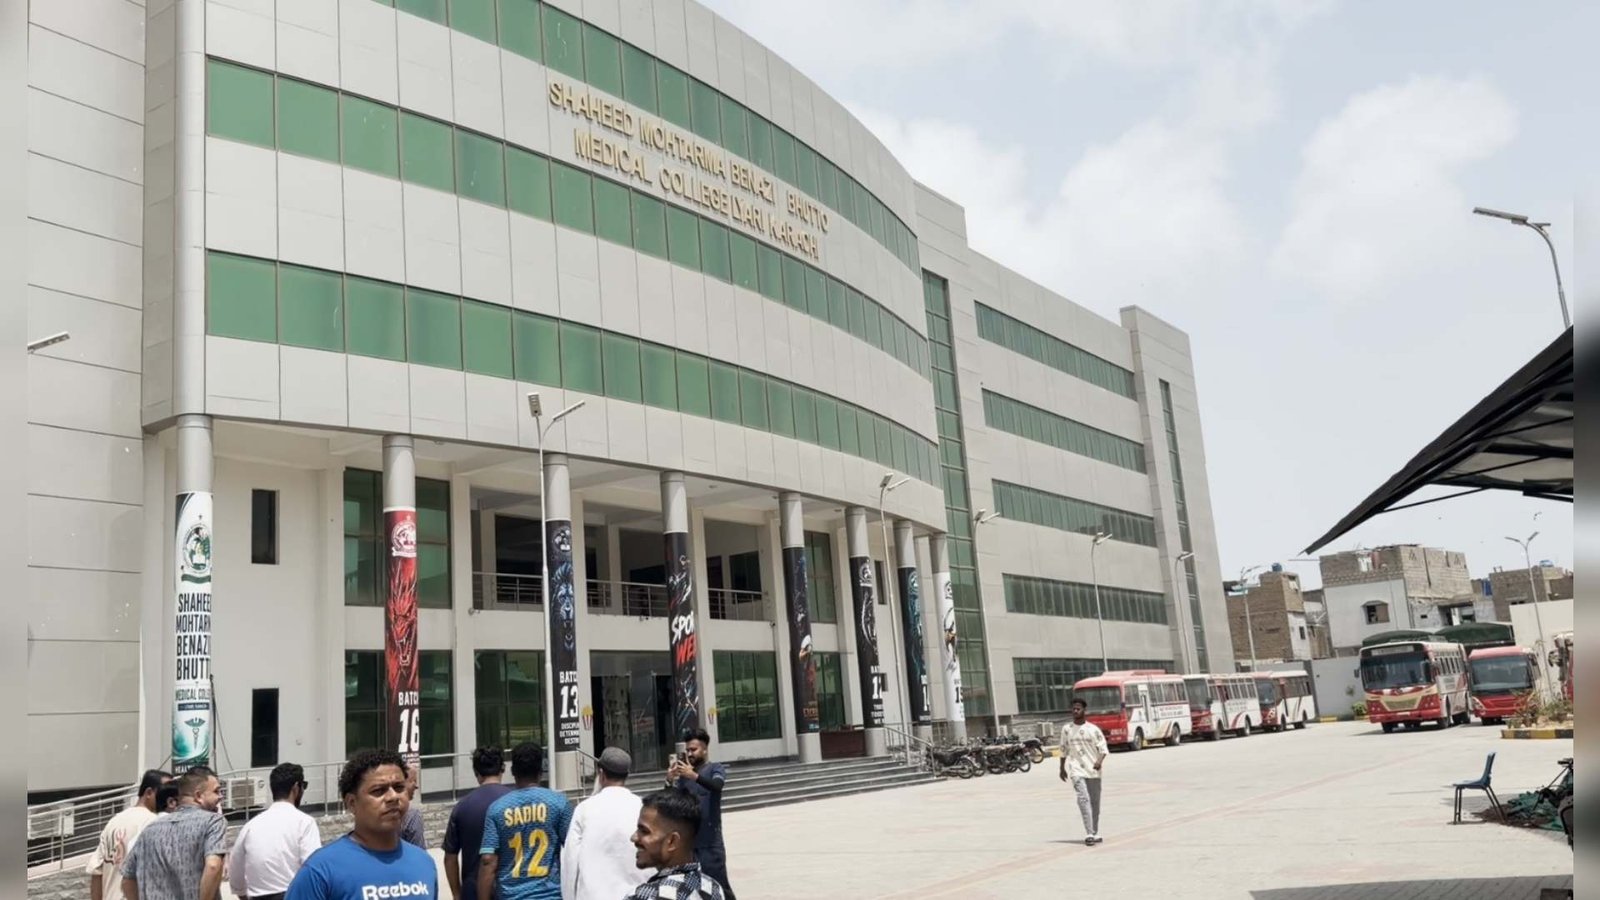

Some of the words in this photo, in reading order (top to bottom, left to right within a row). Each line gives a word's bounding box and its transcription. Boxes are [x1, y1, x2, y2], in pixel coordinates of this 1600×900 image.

[549, 82, 634, 138] SHAHEED
[639, 115, 726, 181] MOHTARMA
[786, 189, 829, 233] BHUTTO
[574, 127, 653, 186] MEDICAL
[659, 163, 729, 217] COLLEGE
[730, 194, 765, 233] LYARI
[768, 212, 820, 260] KARACHI
[559, 685, 579, 718] 13
[398, 708, 420, 753] 16
[503, 802, 548, 828] SADIQ
[507, 828, 550, 879] 12
[361, 880, 430, 900] Reebok
